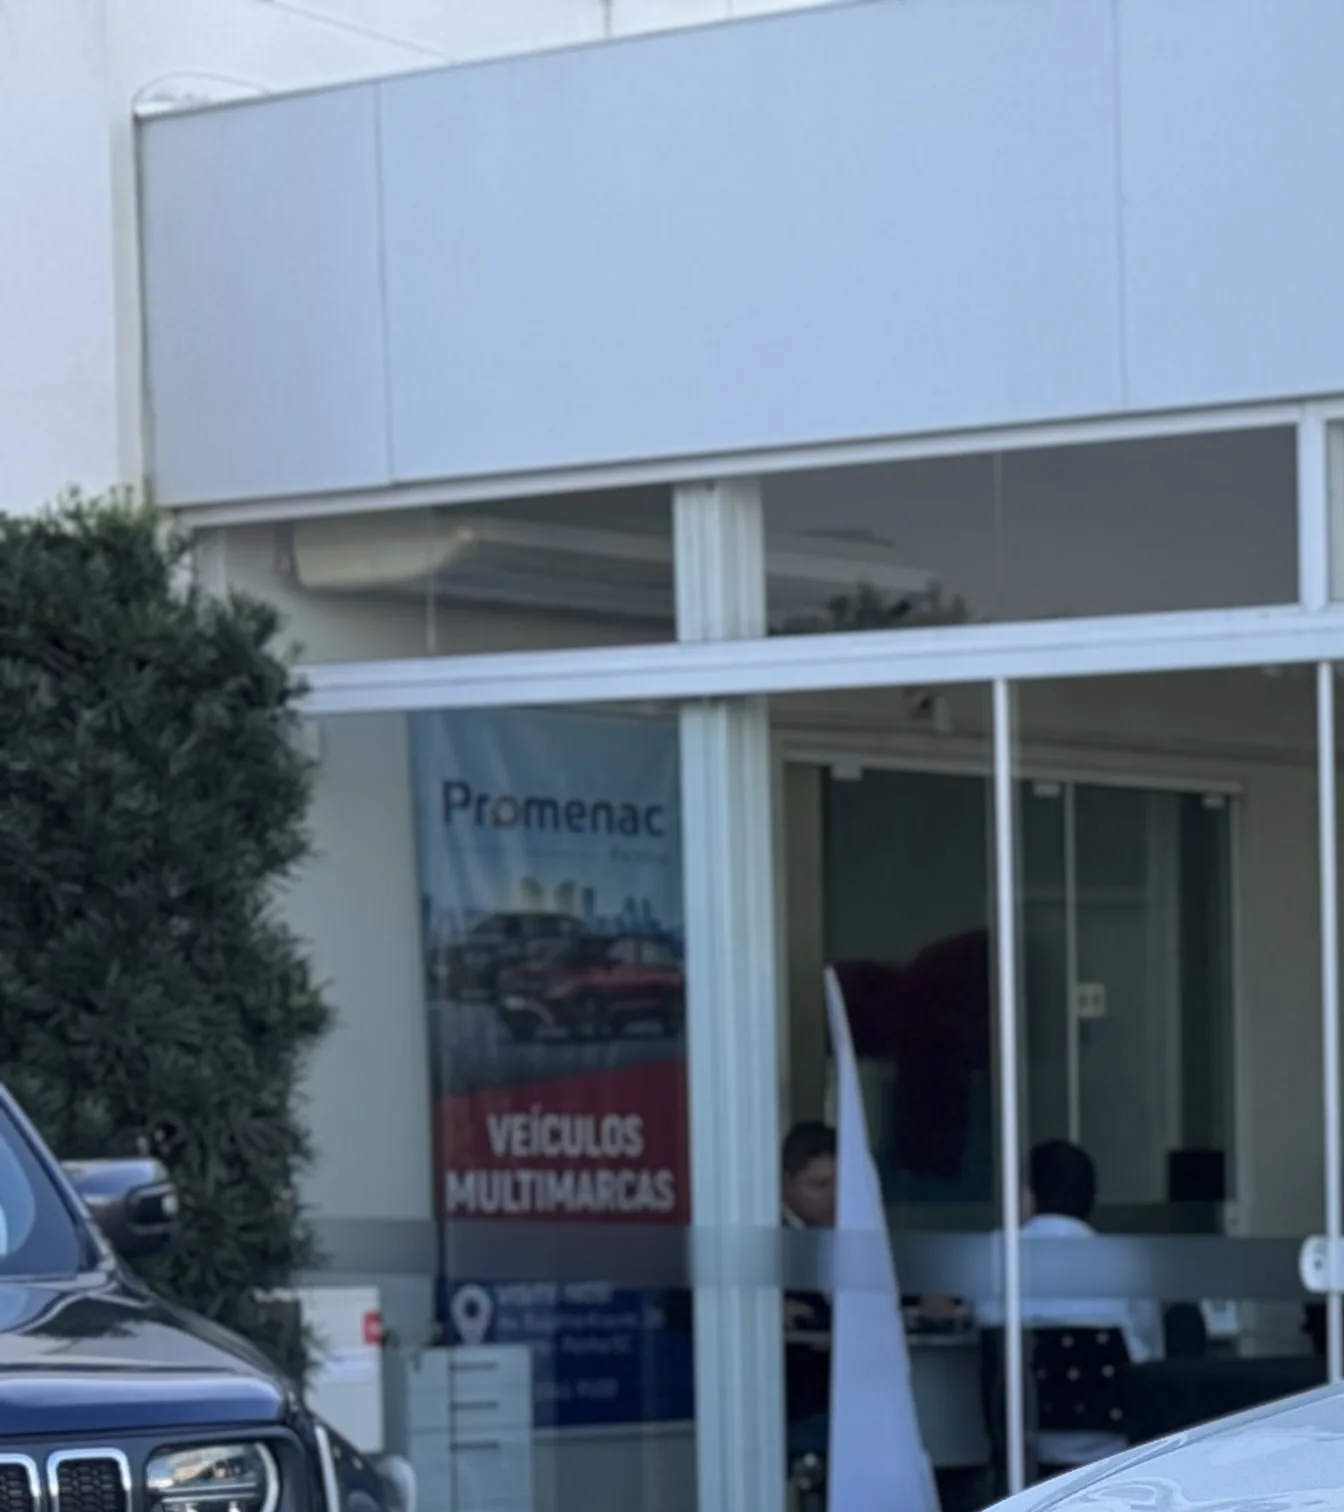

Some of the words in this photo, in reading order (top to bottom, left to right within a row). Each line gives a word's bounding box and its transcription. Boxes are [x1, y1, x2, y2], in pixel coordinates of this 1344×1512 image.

[441, 778, 665, 837] Promenac
[487, 1102, 644, 1158] VEÍCULOS
[445, 1168, 676, 1213] MULTIMARCAS
